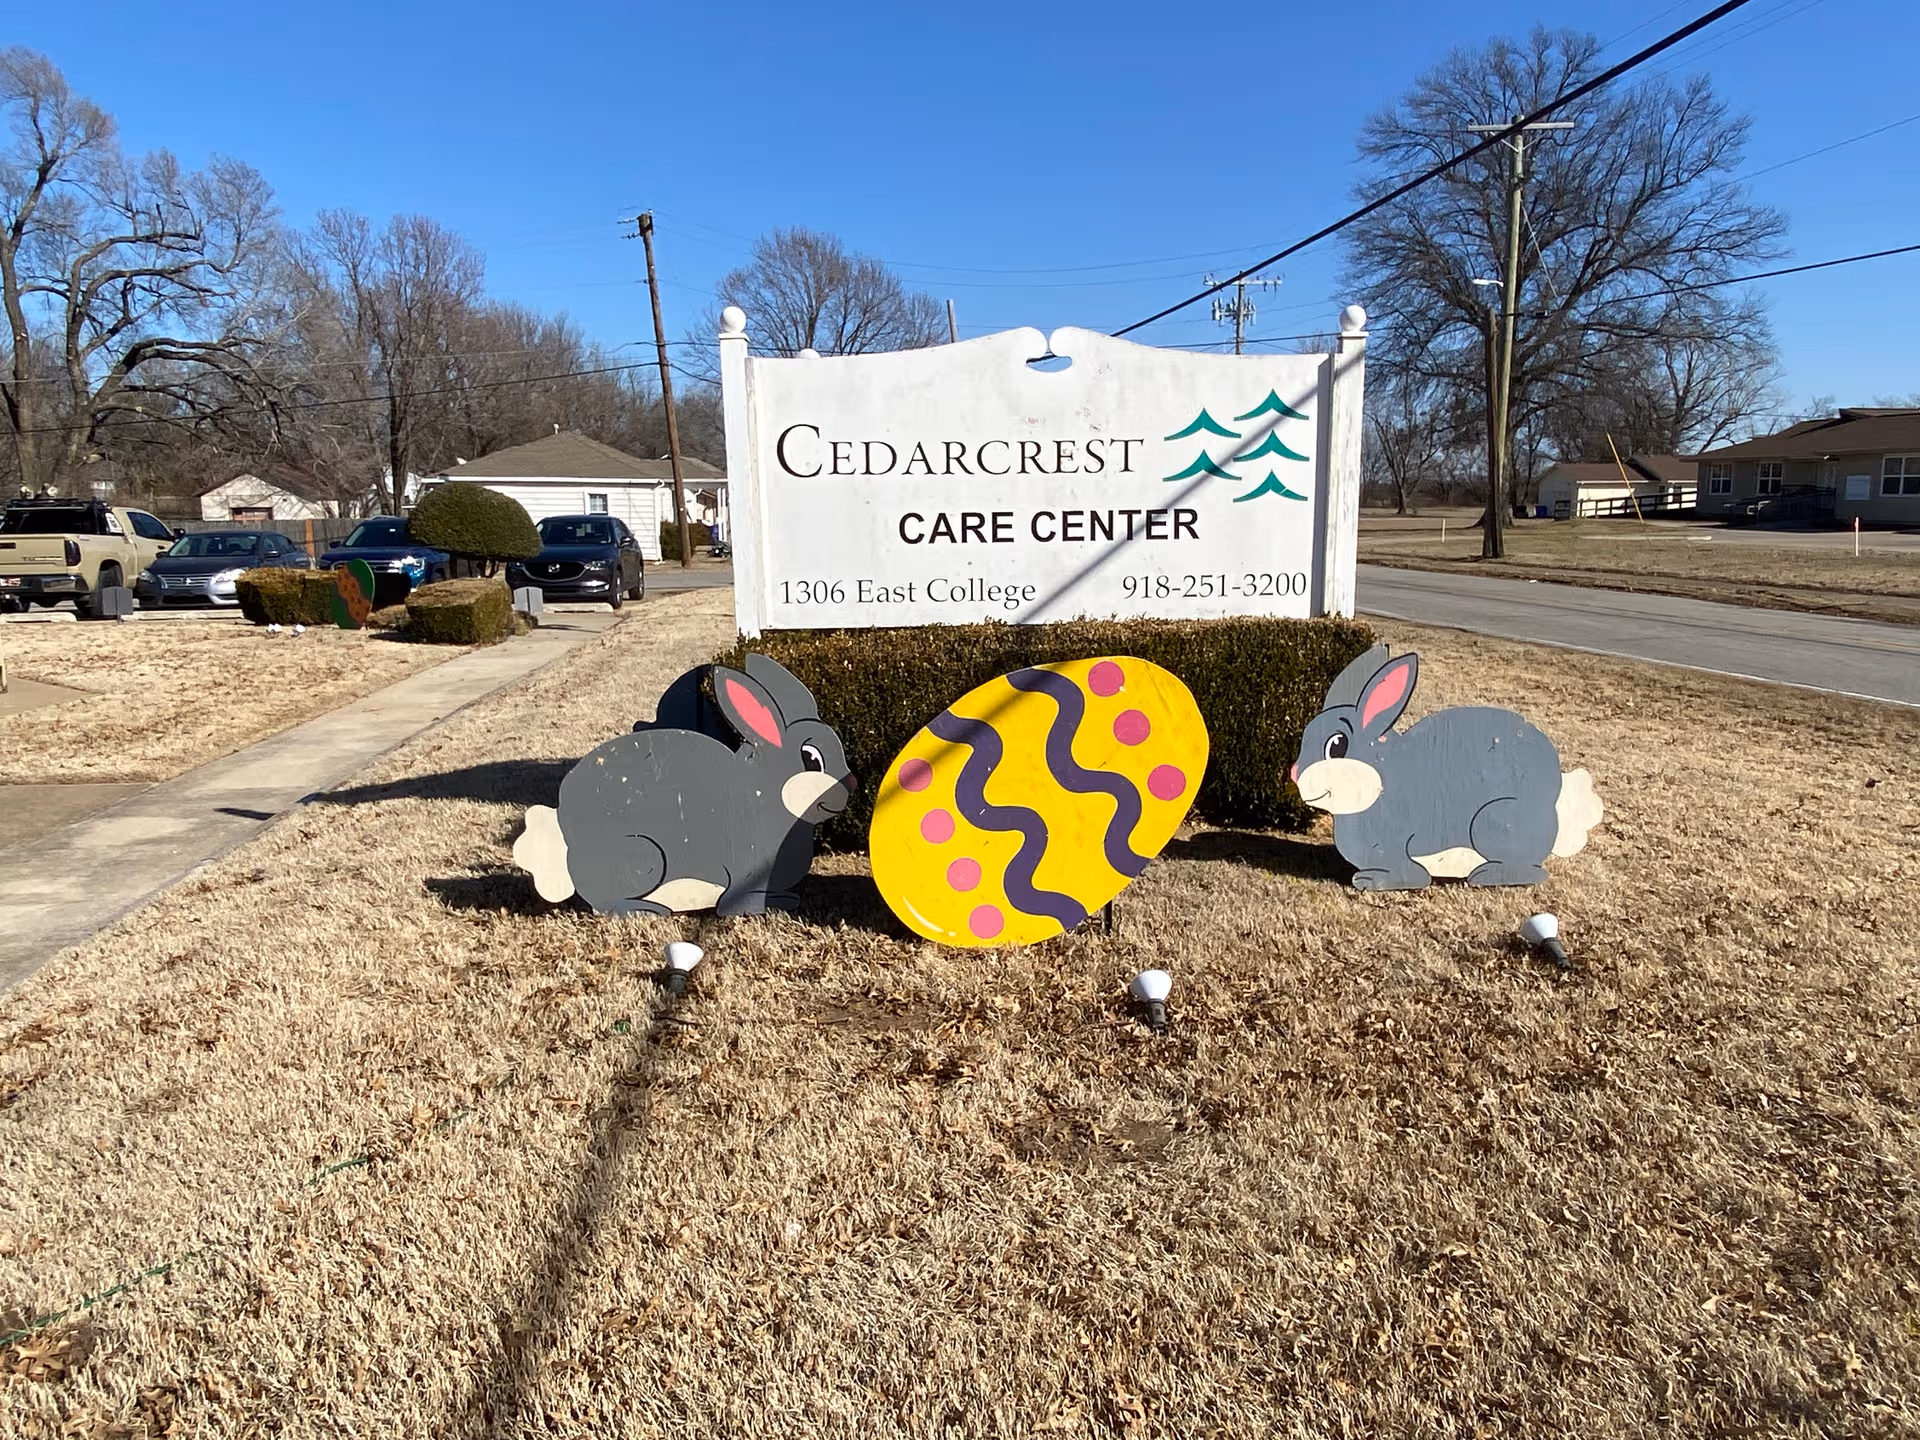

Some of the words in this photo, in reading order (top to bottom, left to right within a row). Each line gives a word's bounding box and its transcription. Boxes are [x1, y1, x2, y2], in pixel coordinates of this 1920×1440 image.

[776, 423, 1144, 478] CEDARCREST
[898, 512, 1015, 544] CARE
[1030, 508, 1200, 542] CENTER
[779, 580, 845, 604] 1306
[857, 579, 917, 603] East
[926, 576, 1036, 609] College
[1122, 572, 1307, 599] 918-251-3200
